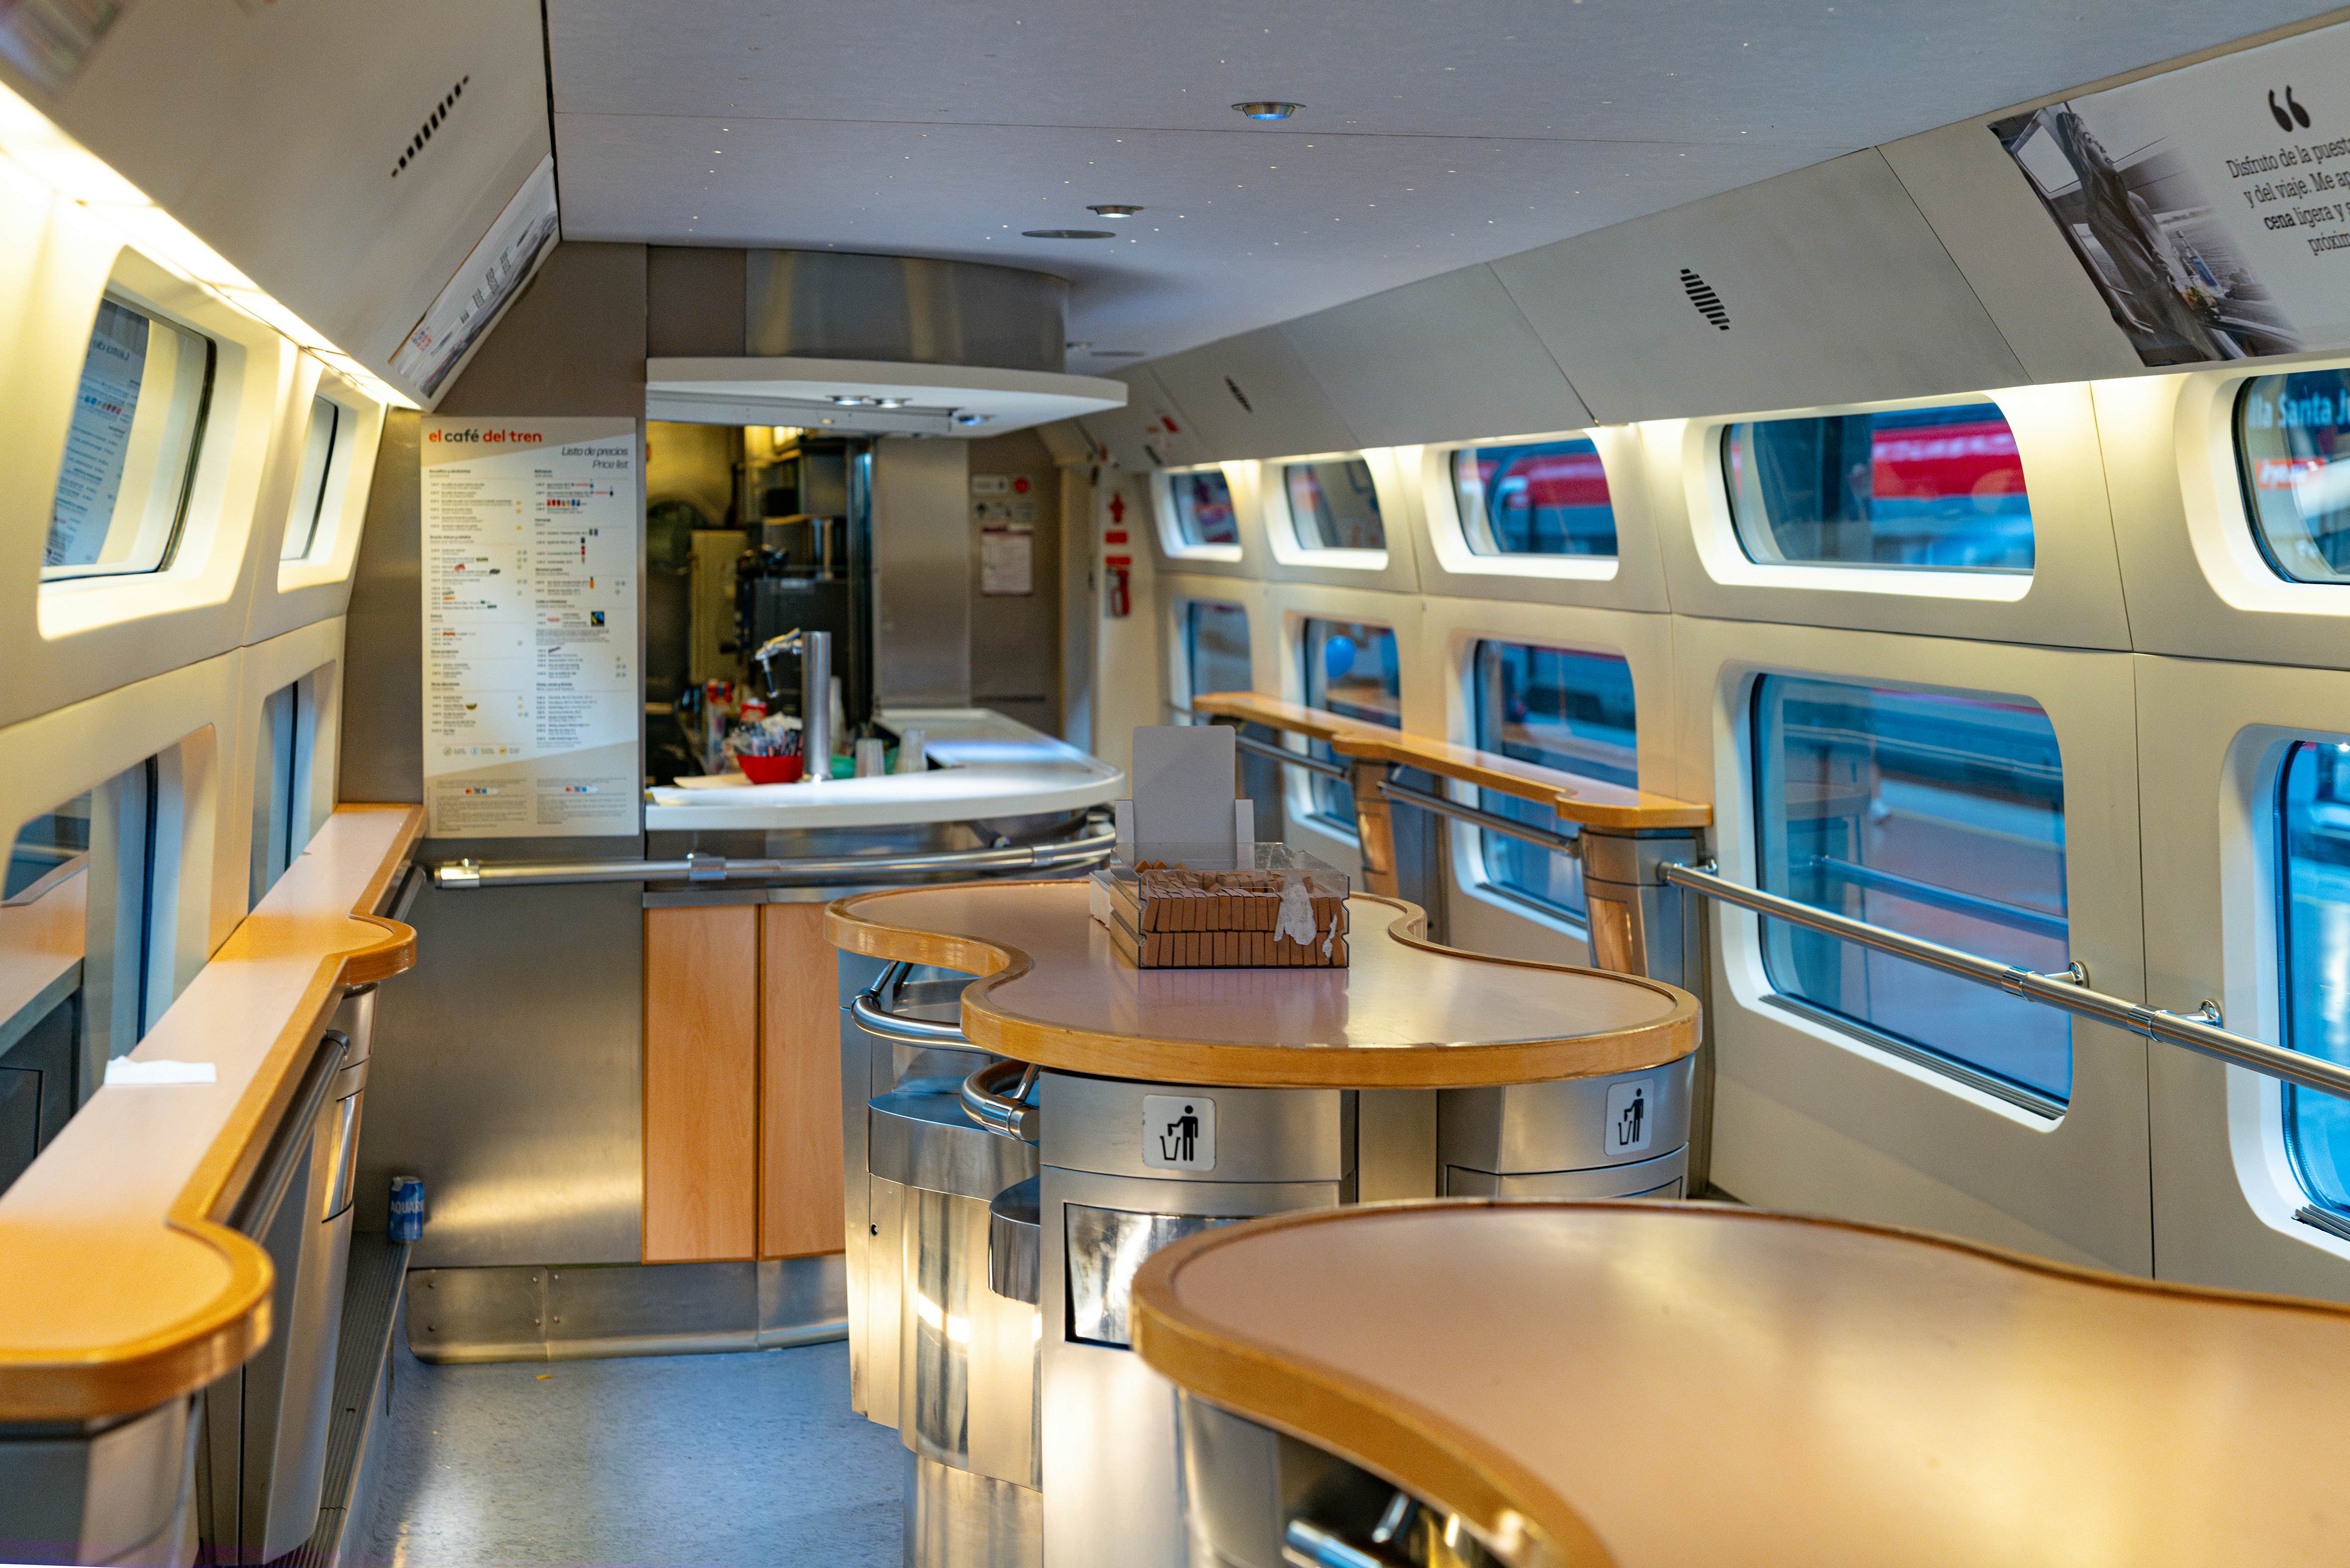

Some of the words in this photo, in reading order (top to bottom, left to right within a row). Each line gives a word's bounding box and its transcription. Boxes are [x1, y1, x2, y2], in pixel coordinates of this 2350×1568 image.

[2226, 155, 2279, 179] Disfruto
[2279, 148, 2297, 167] de
[2295, 145, 2313, 164] la
[2312, 137, 2350, 165] puest
[2244, 191, 2254, 208] y
[2255, 183, 2277, 202] del
[2275, 177, 2313, 199] viaje.
[2310, 172, 2336, 192] Me
[2336, 169, 2350, 191] ap
[2264, 211, 2297, 230] cena
[2293, 206, 2335, 228] ligera
[2333, 203, 2345, 222] y
[2307, 230, 2350, 256] próxim
[2278, 391, 2332, 428] Santa
[2337, 388, 2350, 425] J
[429, 429, 442, 443] el
[444, 429, 479, 443] café
[483, 429, 505, 443] del
[511, 430, 542, 443] tren
[562, 447, 584, 457] Lista
[584, 447, 595, 457] de
[596, 447, 629, 458] precios
[592, 460, 615, 469] Price
[615, 460, 629, 469] list
